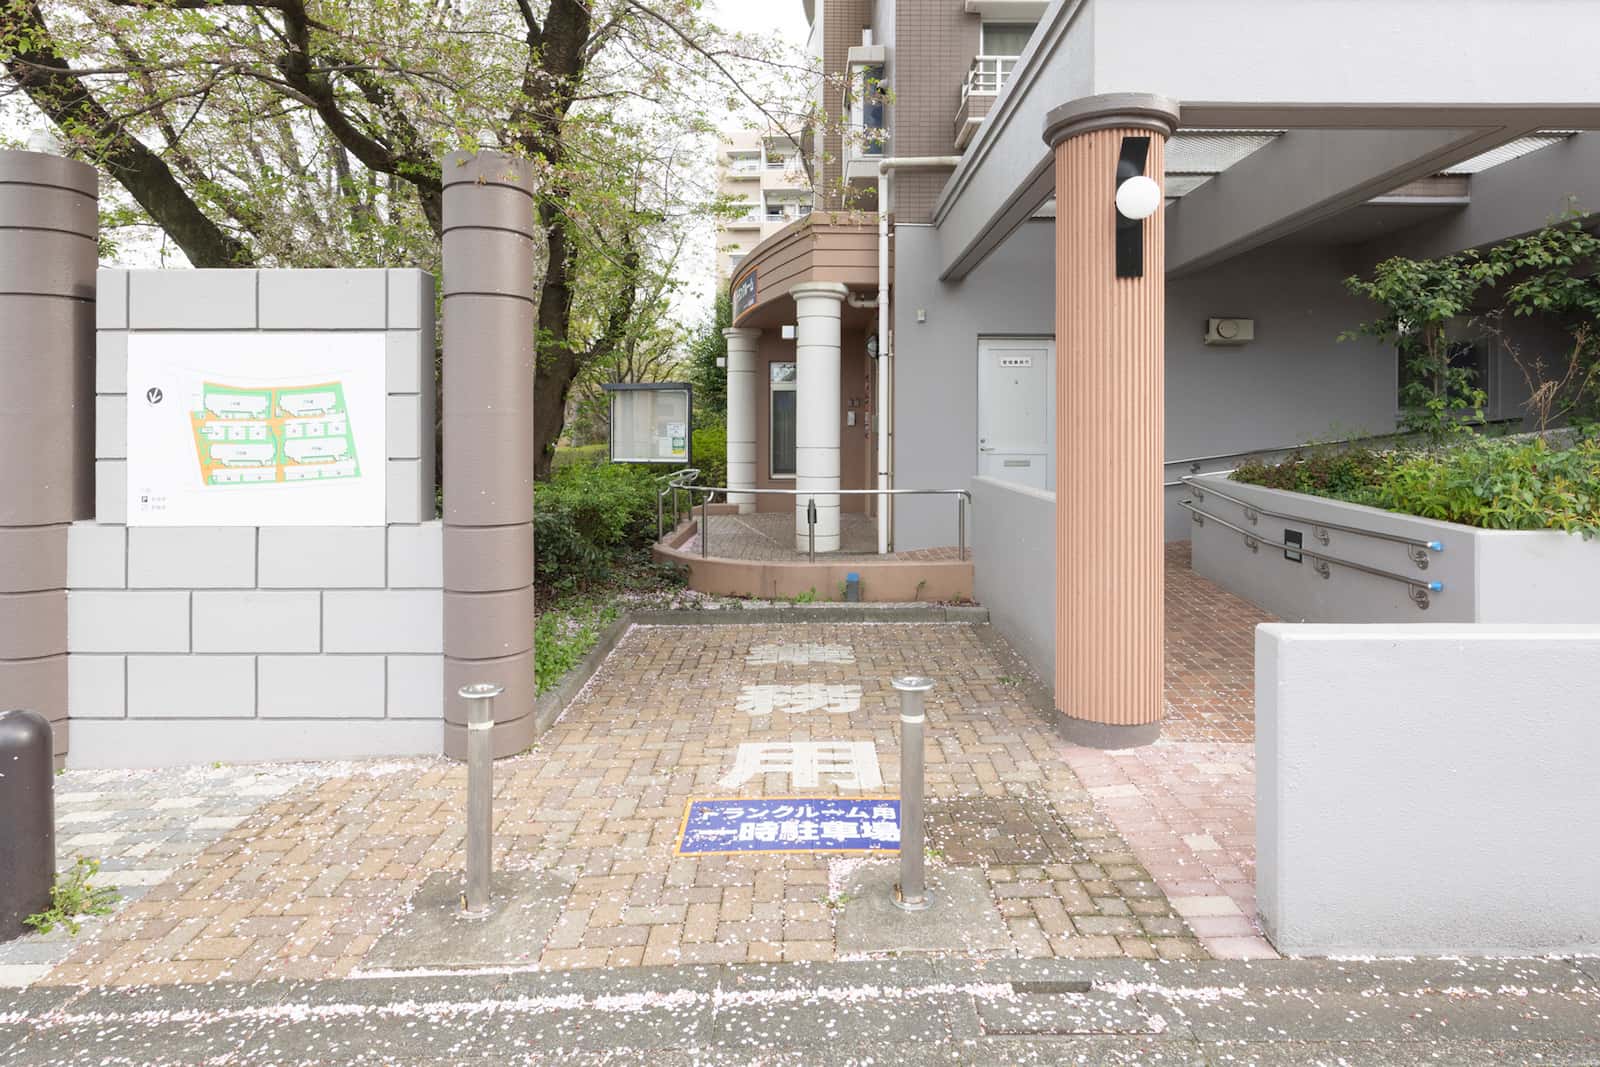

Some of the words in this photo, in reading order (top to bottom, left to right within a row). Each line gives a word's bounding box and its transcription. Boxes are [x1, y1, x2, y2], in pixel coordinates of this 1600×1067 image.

[702, 806, 897, 820] トランクルーム用
[690, 821, 900, 842] 一時駐車場
